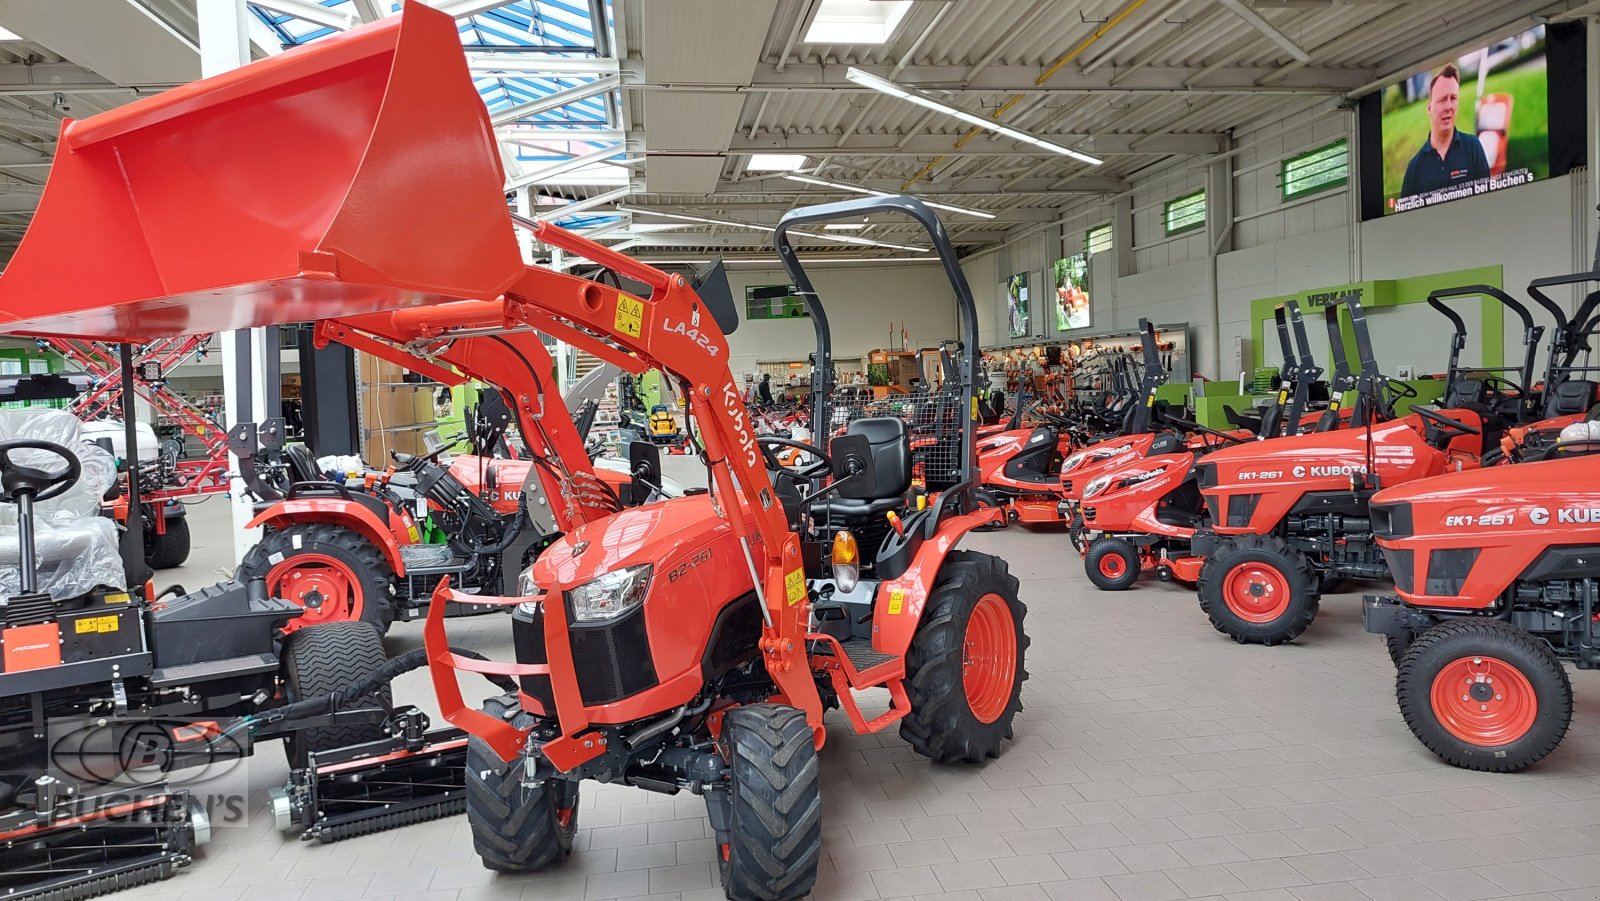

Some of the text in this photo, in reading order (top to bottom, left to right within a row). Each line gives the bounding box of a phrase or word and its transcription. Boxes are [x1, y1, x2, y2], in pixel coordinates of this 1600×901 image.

[1395, 197, 1424, 212] Herzlich
[1426, 187, 1473, 206] willkommen
[1474, 182, 1489, 194] bei
[1490, 174, 1524, 191] Buchen
[663, 317, 719, 357] LA424
[722, 381, 757, 468] Kubota
[1138, 468, 1164, 480] Kubota
[1238, 470, 1283, 480] EK1-261
[1310, 465, 1368, 477] KUBOTA
[1445, 514, 1515, 527] EK1-261
[669, 548, 712, 583] B2-261
